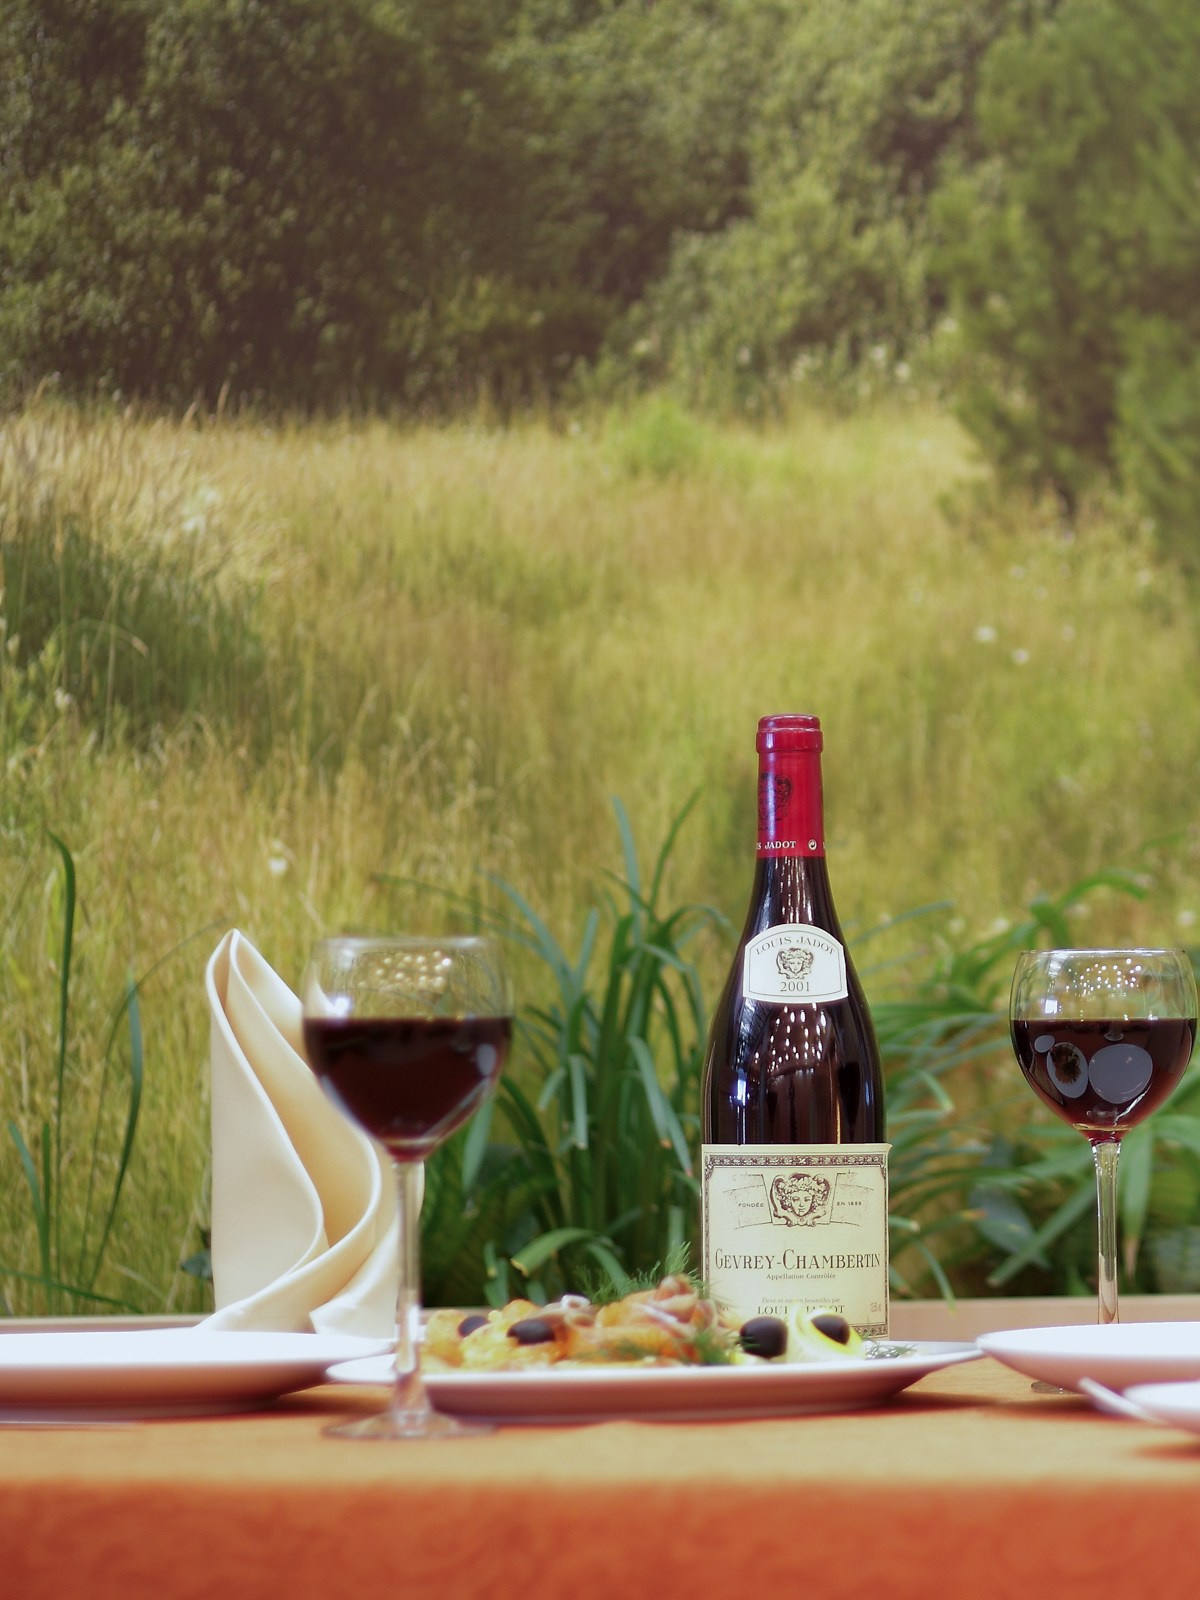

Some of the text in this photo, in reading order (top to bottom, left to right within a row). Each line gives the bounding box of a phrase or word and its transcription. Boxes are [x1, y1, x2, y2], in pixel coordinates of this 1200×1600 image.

[764, 840, 797, 850] JADOT
[756, 936, 834, 955] LOUIS JADOT
[780, 981, 810, 992] 2001
[715, 1248, 881, 1270] GEVREY-CHAMBERTIN
[766, 1272, 836, 1281] Appellation Contrôlée
[757, 1305, 789, 1315] LOUI
